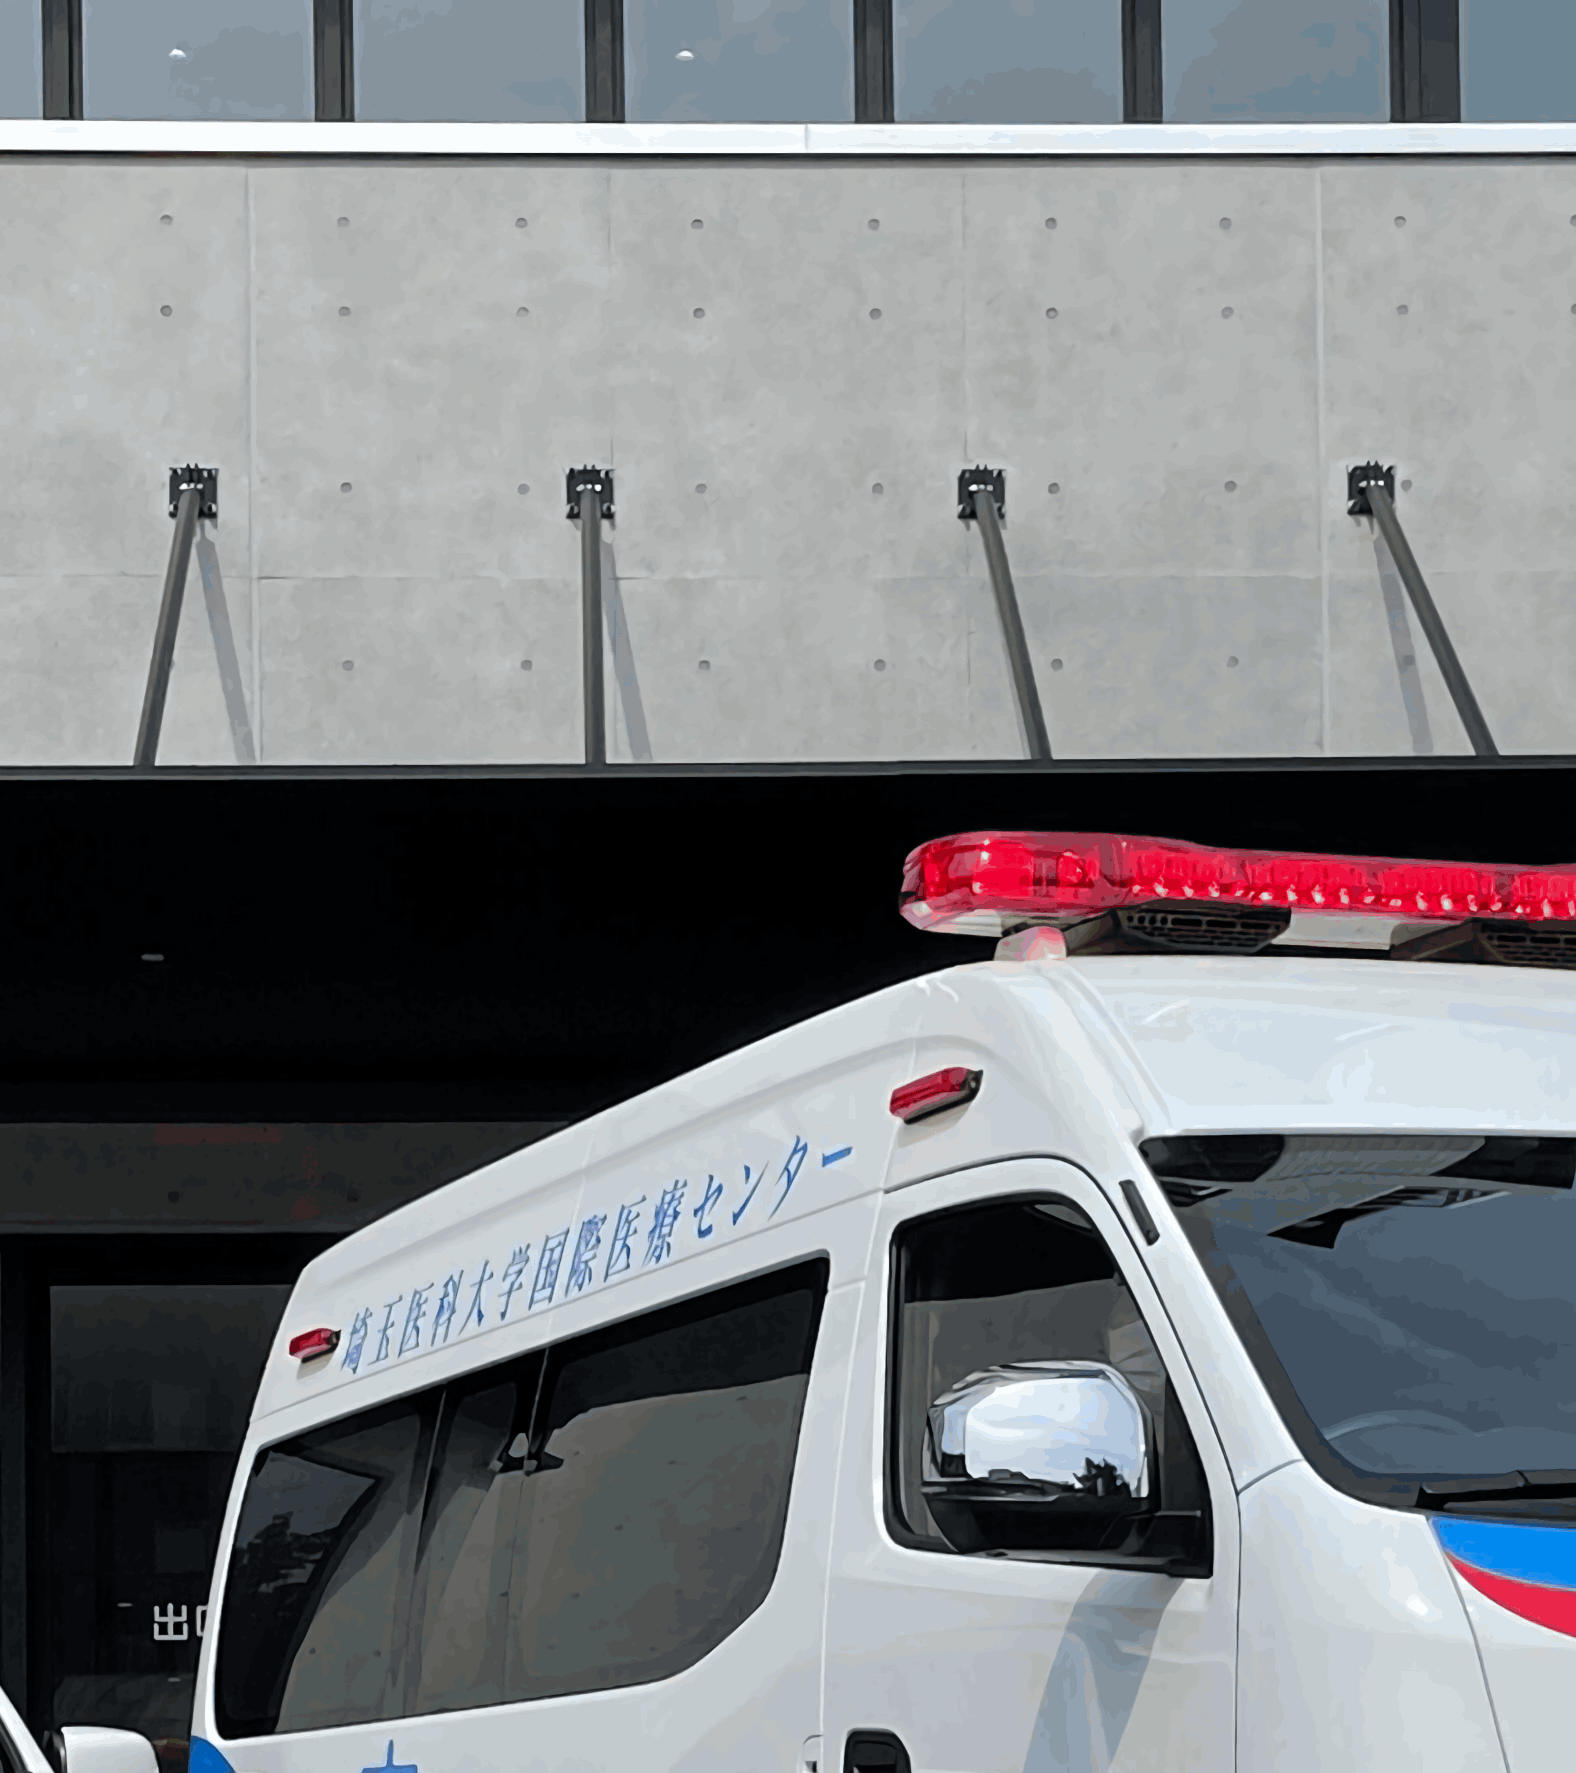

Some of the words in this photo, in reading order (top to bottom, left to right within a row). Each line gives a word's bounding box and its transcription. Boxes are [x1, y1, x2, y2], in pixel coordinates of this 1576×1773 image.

[341, 1134, 854, 1374] 埼玉医科大学国際医療センター
